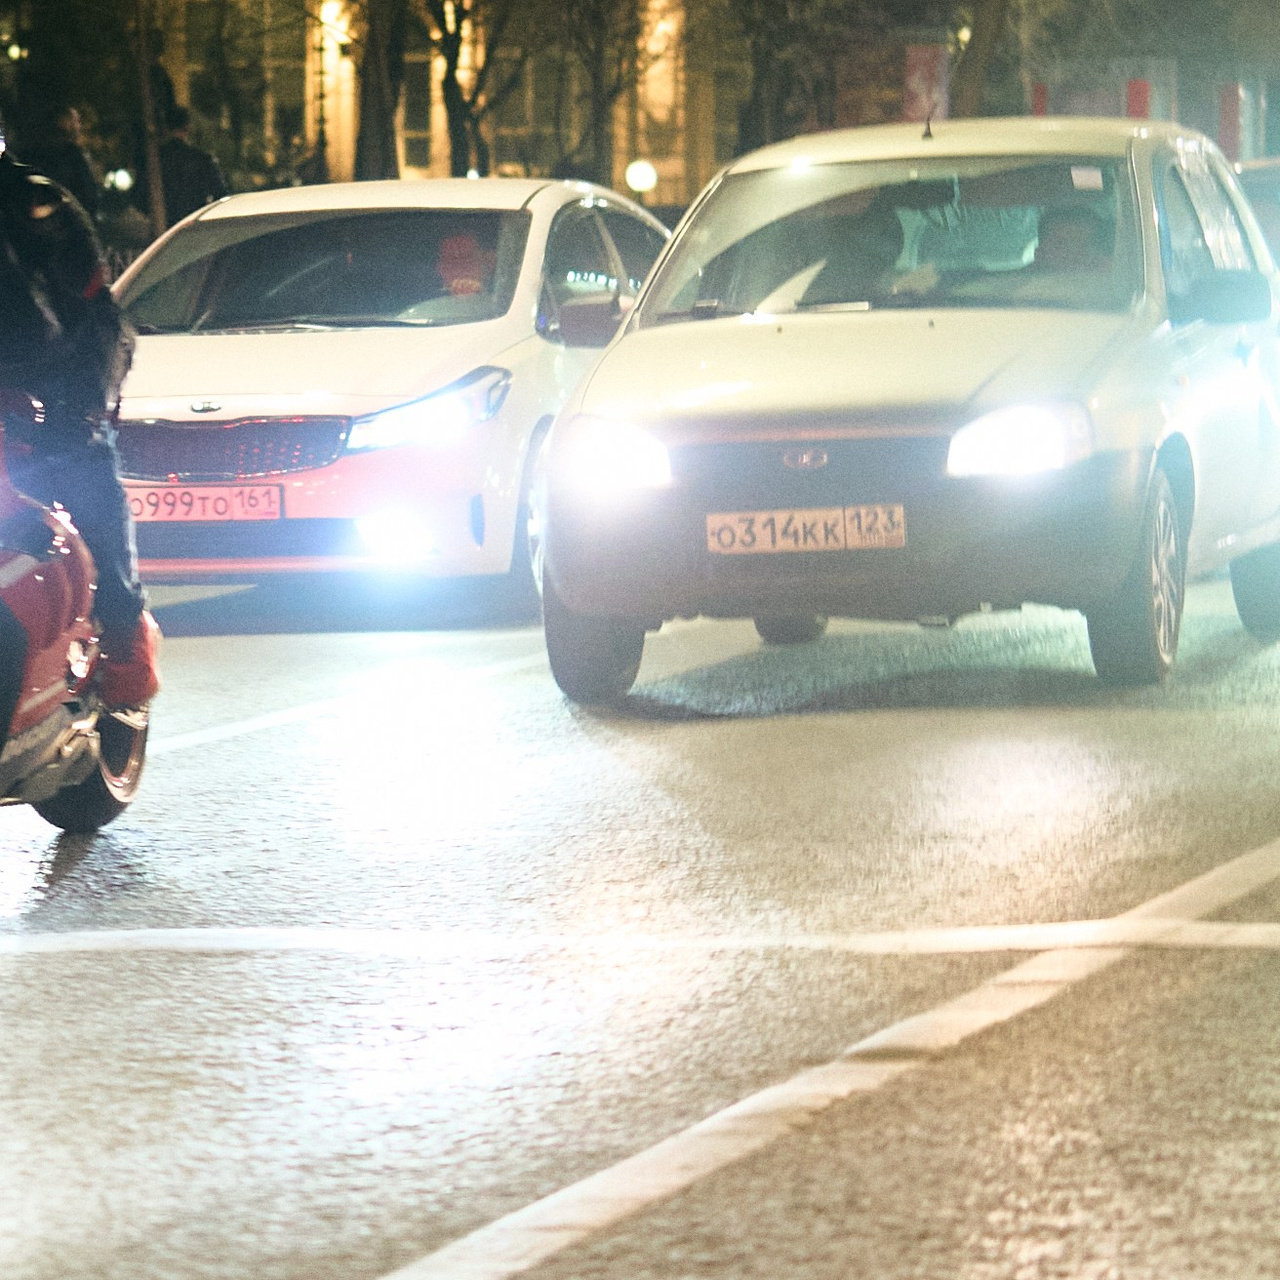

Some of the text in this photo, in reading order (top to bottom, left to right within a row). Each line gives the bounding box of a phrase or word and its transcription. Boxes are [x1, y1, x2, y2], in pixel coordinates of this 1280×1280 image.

[235, 488, 272, 509] 161
[717, 513, 840, 549] О314КК
[849, 508, 897, 535] 123
